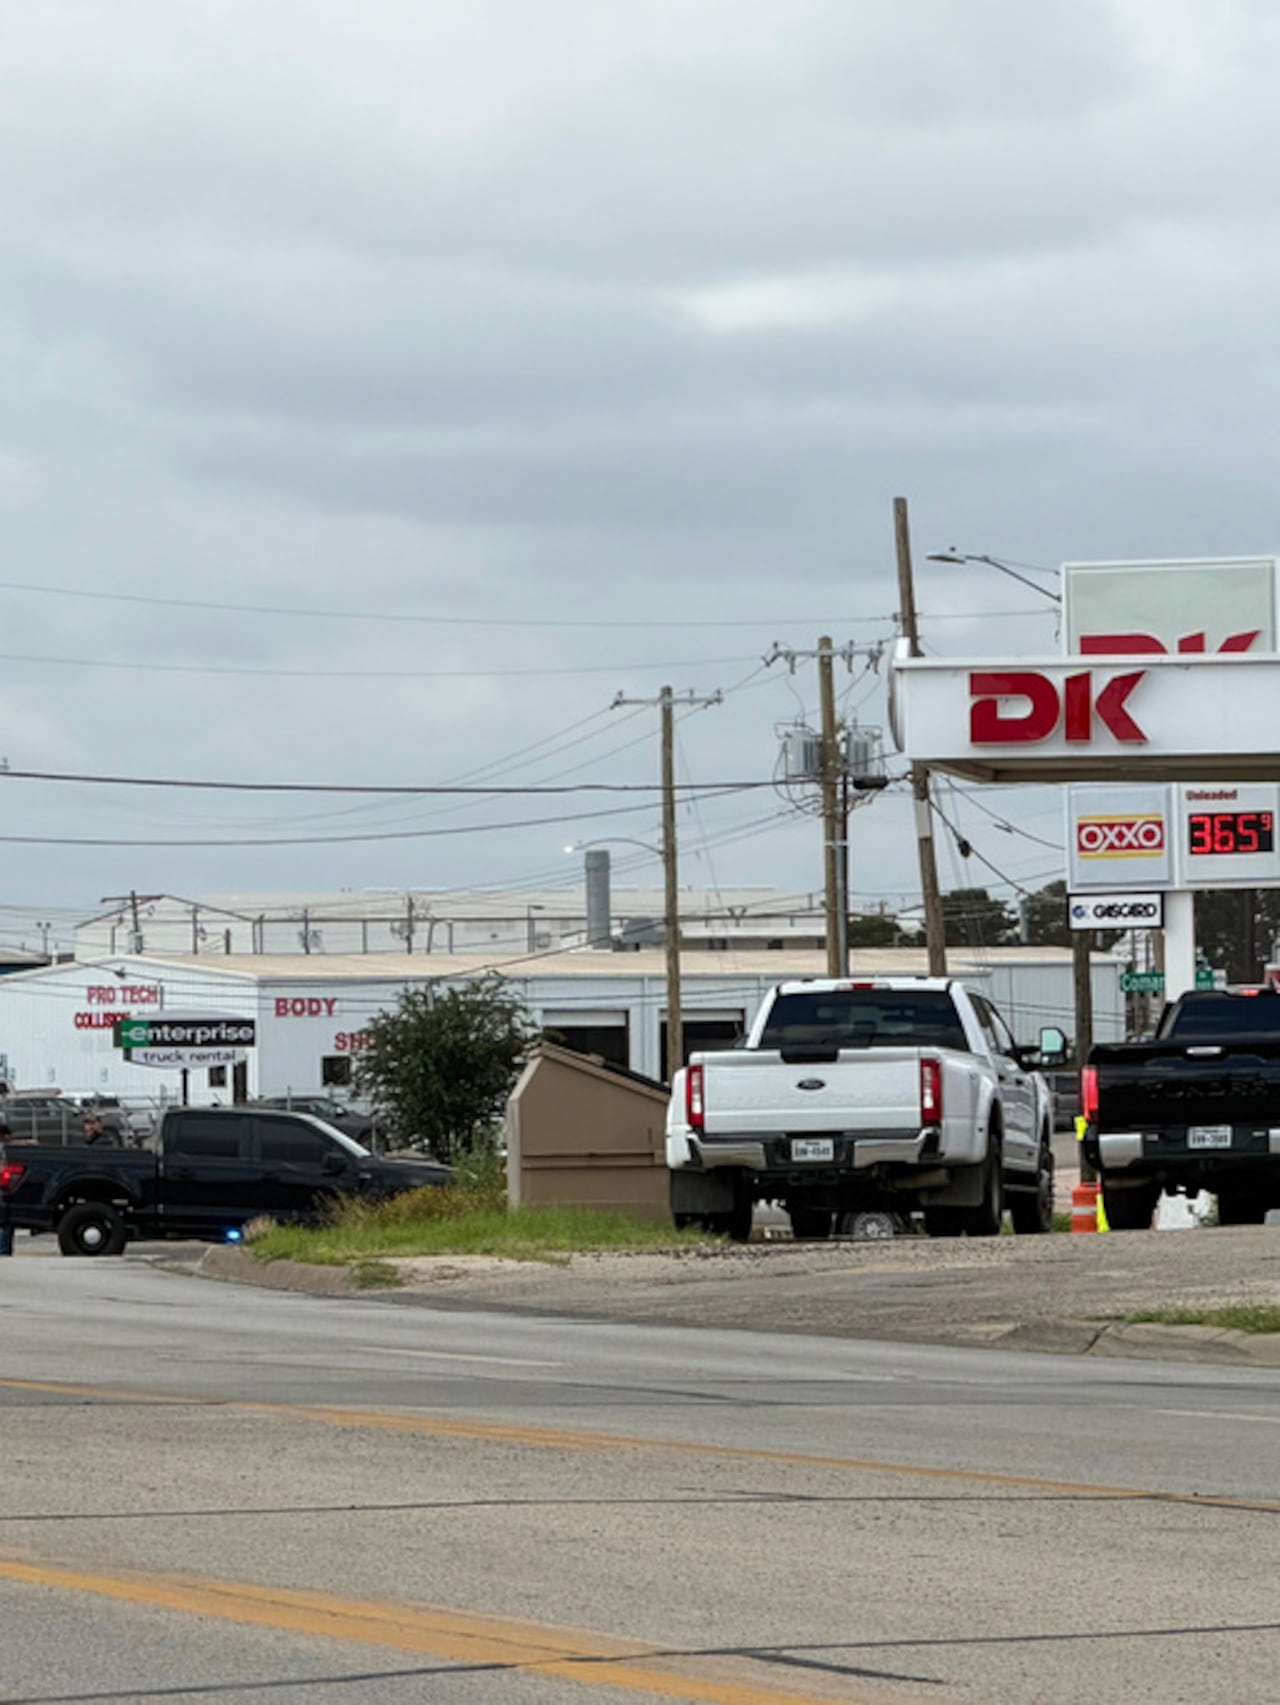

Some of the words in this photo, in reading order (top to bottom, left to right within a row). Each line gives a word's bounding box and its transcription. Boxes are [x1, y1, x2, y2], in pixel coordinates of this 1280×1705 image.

[970, 670, 1150, 744] DK
[1186, 789, 1237, 800] Unleaded
[1079, 820, 1161, 853] OXXO
[1093, 903, 1157, 918] GASCARD
[87, 987, 115, 1004] PRO
[121, 986, 158, 1004] TECH
[275, 997, 336, 1017] BODY
[129, 1022, 253, 1044] enterprise
[144, 1051, 182, 1062] truck
[190, 1050, 235, 1062] rental
